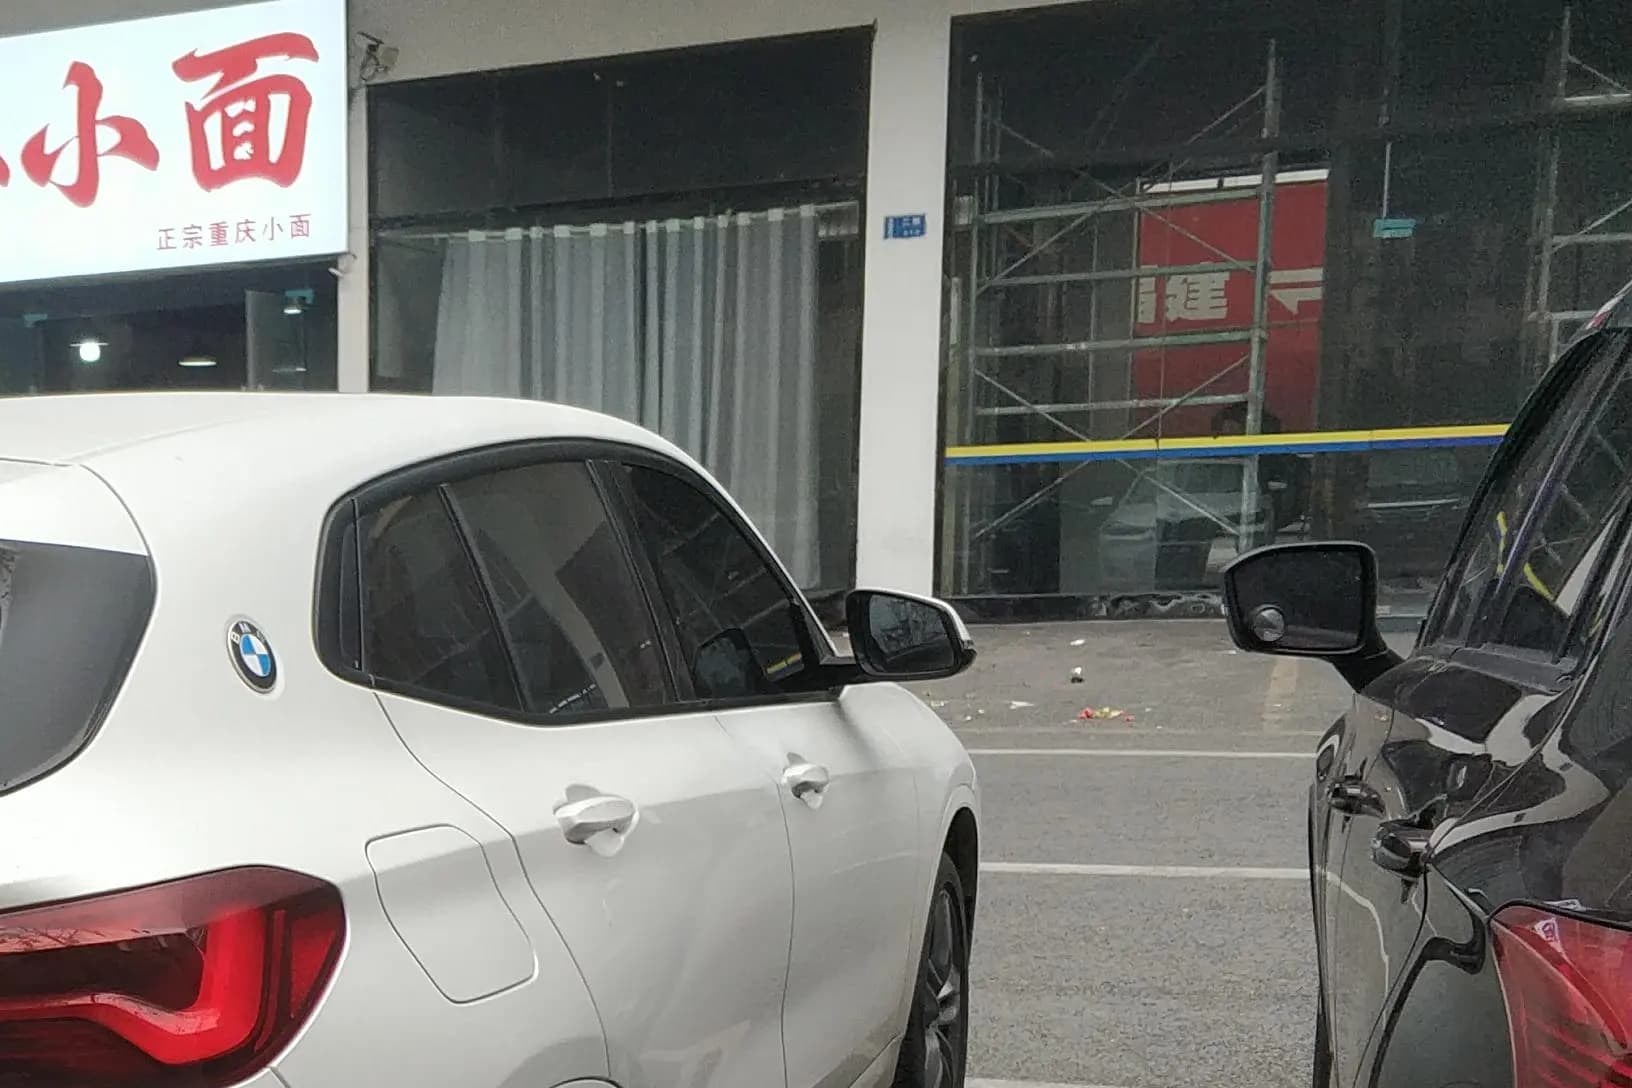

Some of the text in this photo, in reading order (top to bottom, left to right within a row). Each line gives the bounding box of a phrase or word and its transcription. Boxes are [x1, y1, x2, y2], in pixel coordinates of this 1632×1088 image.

[157, 213, 312, 250] 正宗重庆小面
